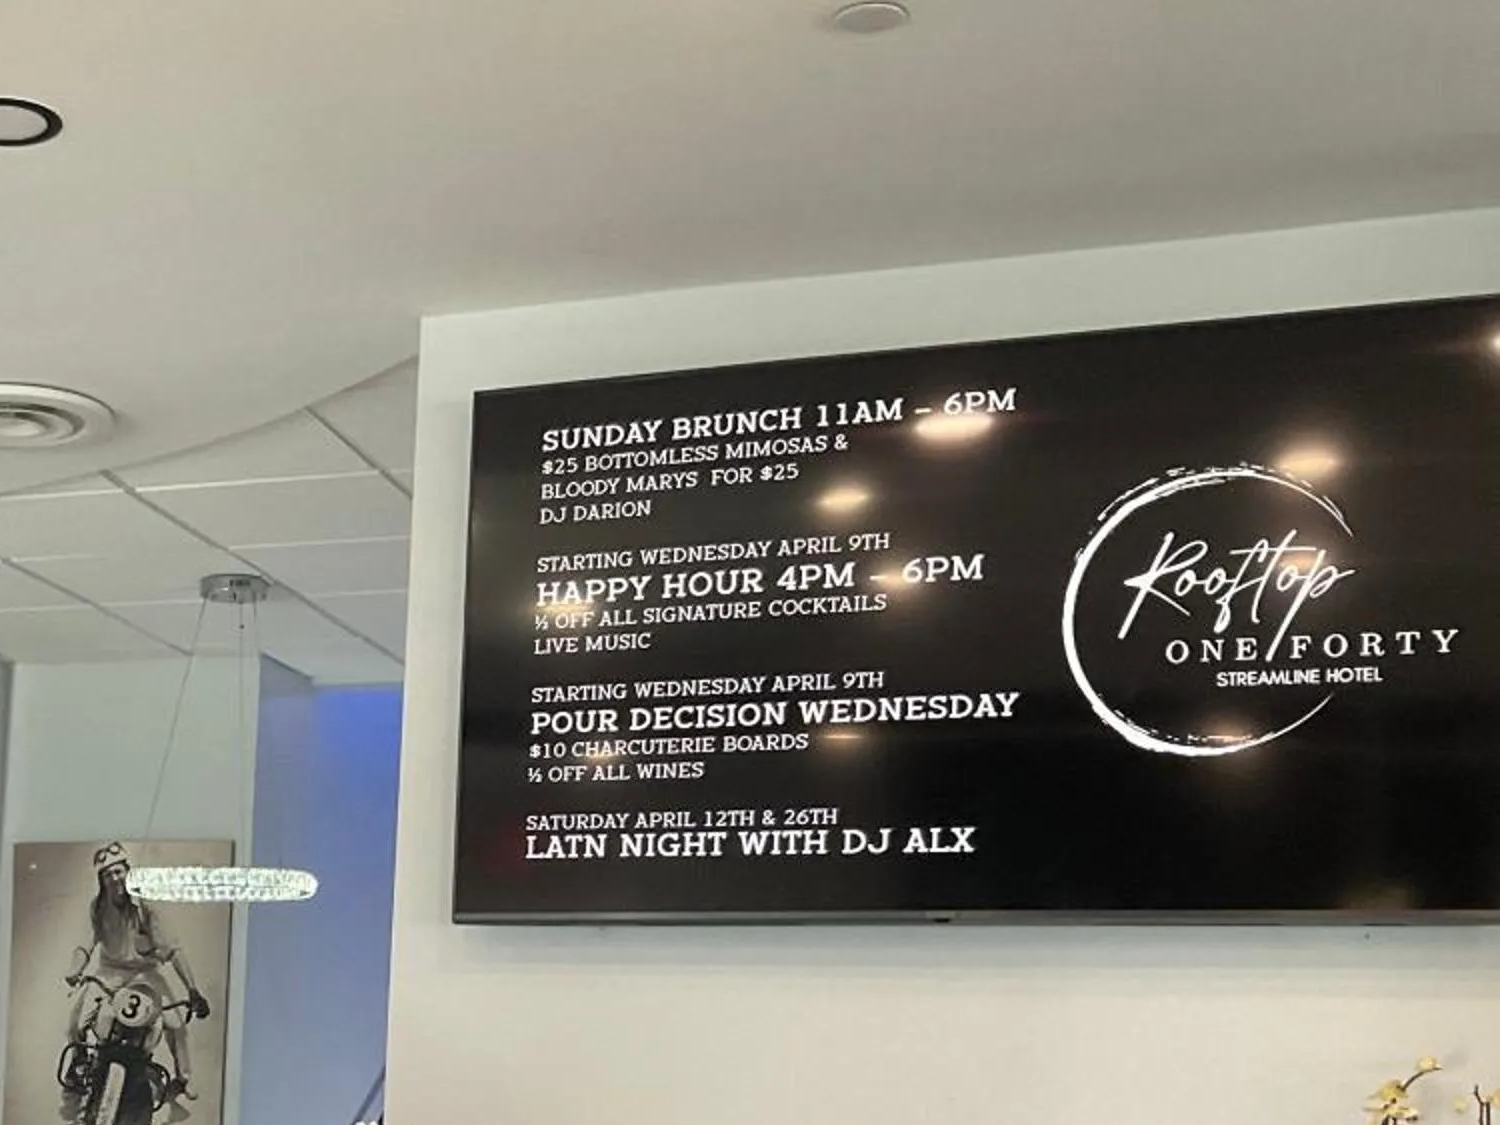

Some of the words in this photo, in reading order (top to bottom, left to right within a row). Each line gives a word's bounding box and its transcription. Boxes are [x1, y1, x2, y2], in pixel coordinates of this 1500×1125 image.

[542, 420, 668, 452] SUNDAY
[673, 407, 801, 440] BRUNCH
[817, 398, 904, 426] 11AM
[943, 388, 1016, 415] 6PM
[542, 456, 578, 474] $25
[585, 445, 718, 473] BOTTOMLESS
[725, 435, 827, 460] MIMOSAS
[834, 434, 848, 451] &
[541, 478, 619, 500] BLOODY
[625, 472, 698, 493] MARYS
[711, 466, 753, 486] FOR
[760, 463, 799, 481] $25
[540, 506, 567, 524] DJ
[573, 500, 651, 521] DARION
[537, 551, 633, 573] STARTING
[641, 540, 772, 564] WEDNESDAY
[778, 536, 842, 555] APRIL
[849, 533, 890, 551] 9TH
[536, 575, 652, 607] HAPPY
[662, 568, 764, 599] HOUR
[777, 563, 856, 590] 4PM
[900, 555, 984, 583] 6PM
[1118, 529, 1355, 662] Rooftop
[555, 611, 593, 630] OFF
[600, 608, 637, 626] ALL
[642, 600, 761, 624] SIGNATURE
[768, 594, 887, 616] COCKTAILS
[534, 637, 578, 655] LIVE
[585, 633, 651, 652] MUSIC
[1165, 637, 1259, 664] ONE
[1290, 628, 1459, 659] FORTY
[531, 682, 627, 703] STARTING
[635, 676, 766, 698] WEDNESDAY
[772, 673, 836, 692] APRIL
[843, 671, 884, 688] 9TH
[1216, 668, 1321, 687] STREAMLINE
[1326, 667, 1383, 683] HOTEL
[531, 708, 618, 735] POUR
[630, 702, 787, 731] DECISION
[799, 692, 1019, 725] WEDNESDAY
[530, 741, 566, 760] $10
[572, 736, 716, 759] CHARCUTERIE
[723, 734, 809, 753] BOARDS
[548, 764, 587, 782] OFF
[593, 765, 630, 781] ALL
[636, 762, 704, 780] WINES
[526, 812, 629, 831] SATURDAY
[635, 810, 696, 829] APRIL
[704, 809, 755, 827] 12TH
[761, 809, 776, 826] &
[783, 808, 838, 825] 26TH
[525, 833, 606, 859] LATN
[620, 831, 726, 857] NIGHT
[739, 830, 828, 855] WITH
[842, 829, 891, 855] DJ
[903, 827, 975, 853] ALX
[122, 995, 141, 1018] 3
